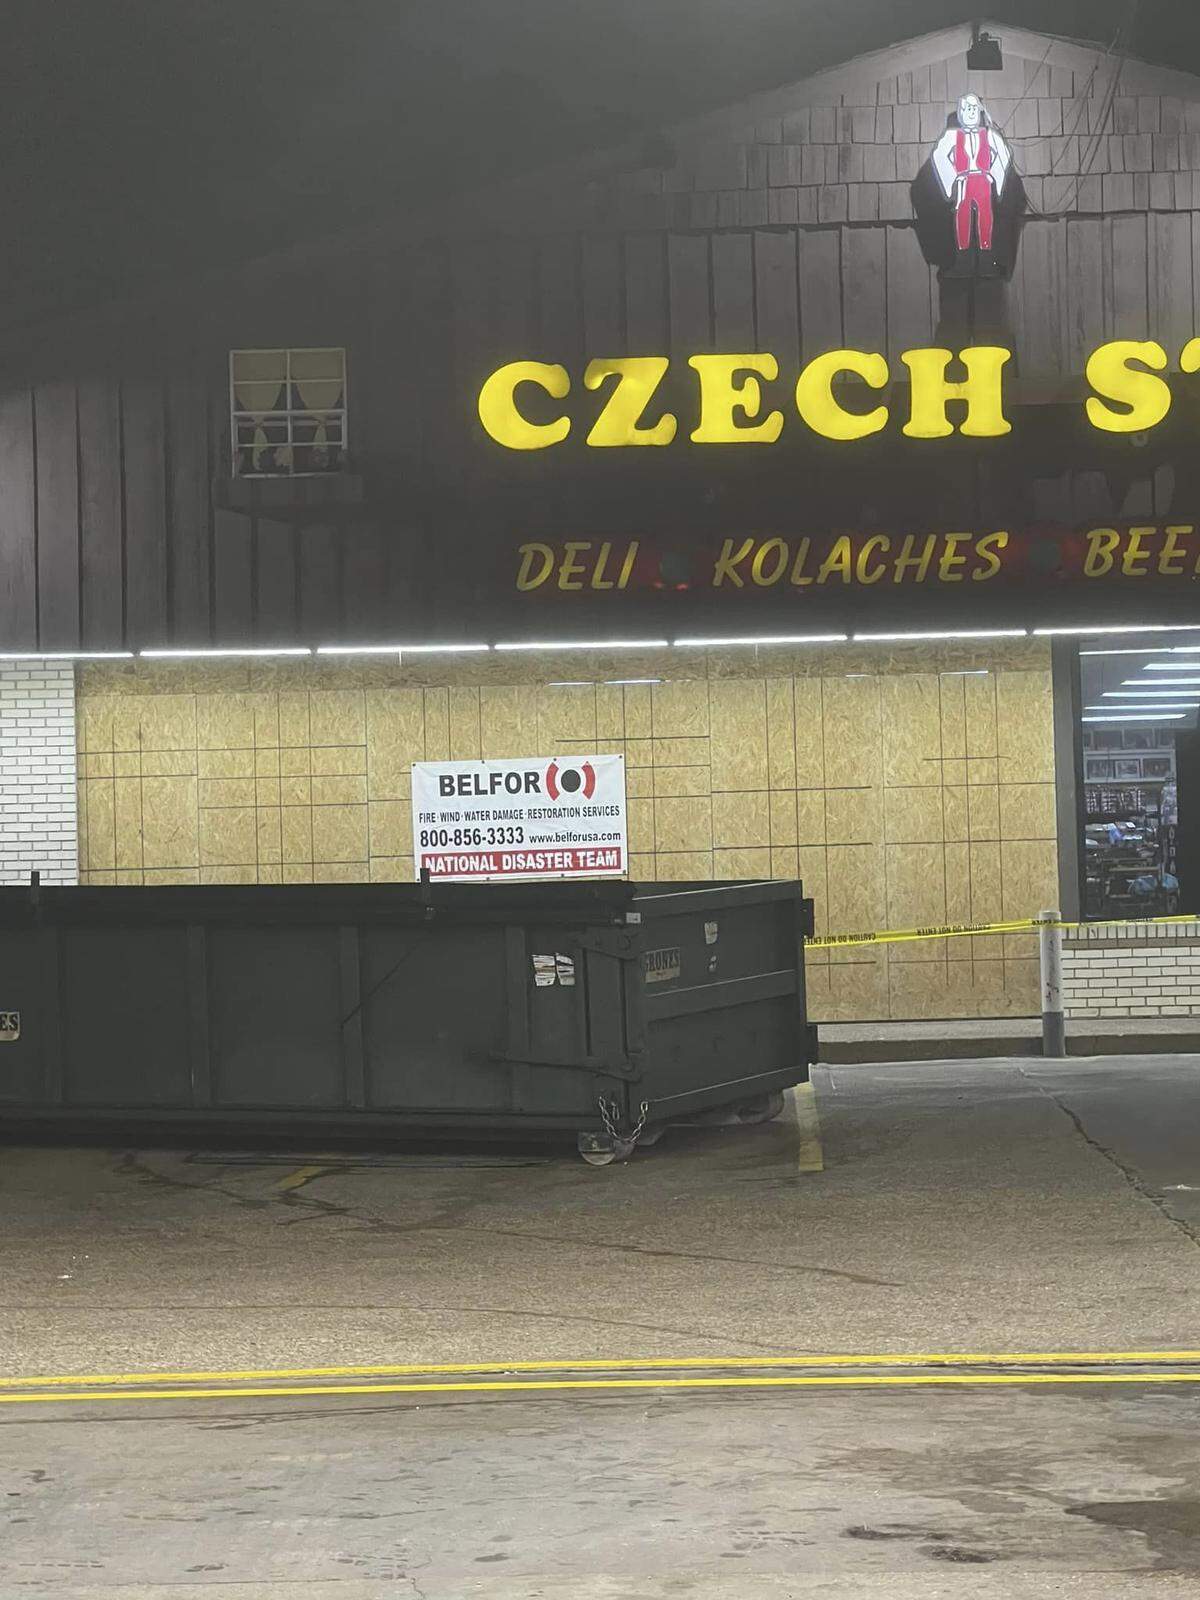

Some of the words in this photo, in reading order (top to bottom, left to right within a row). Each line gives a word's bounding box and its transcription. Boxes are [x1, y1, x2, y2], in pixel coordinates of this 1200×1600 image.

[478, 346, 1012, 450] CZECH
[1086, 337, 1200, 433] S
[516, 541, 639, 591] DELI
[712, 531, 1009, 587] KOLACHES
[1083, 525, 1200, 577] BEE
[439, 771, 541, 797] BELFOR
[419, 812, 436, 824] FIRE
[440, 811, 461, 823] WIND
[464, 810, 491, 821] WATER
[492, 808, 524, 820] DAMAGE
[527, 807, 581, 819] RESTORATION
[583, 805, 620, 817] SERVICES
[420, 826, 524, 847] 800-856-3333
[529, 831, 621, 844] www.belforusa.com
[425, 855, 498, 874] NATIONAL
[502, 852, 573, 871] DISASTER
[577, 850, 618, 868] TEAM
[823, 936, 837, 944] NOT
[837, 935, 848, 943] DO
[848, 932, 876, 942] CAUTION
